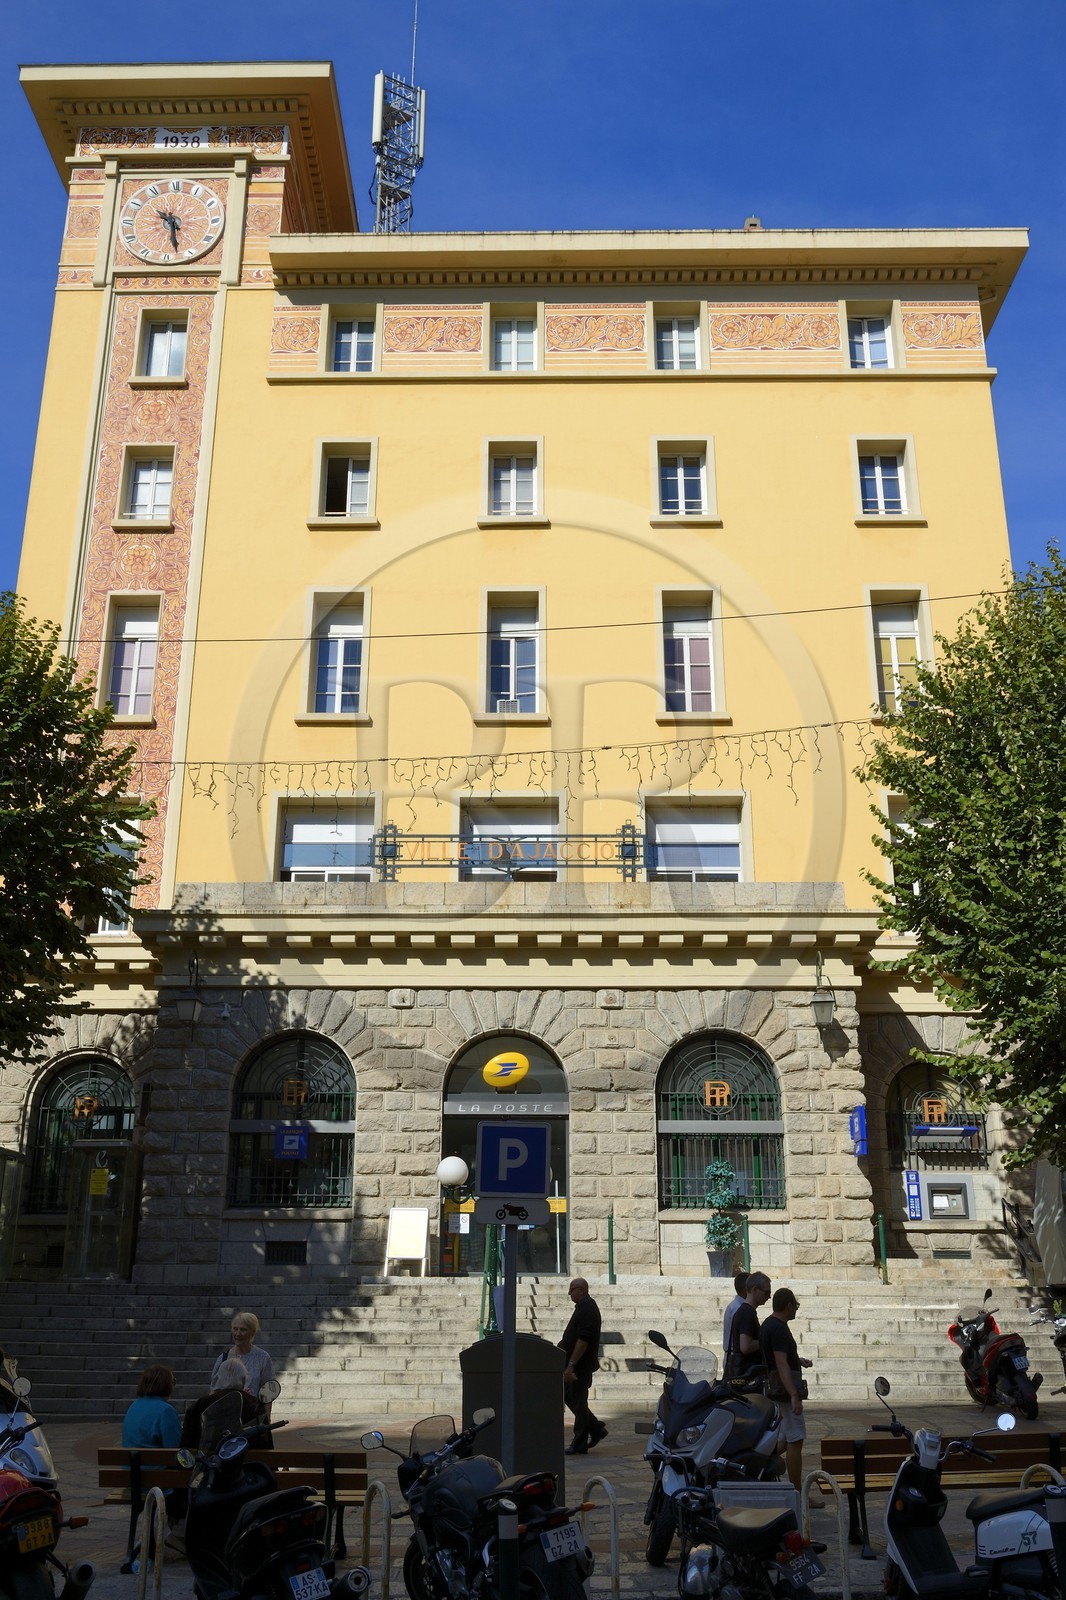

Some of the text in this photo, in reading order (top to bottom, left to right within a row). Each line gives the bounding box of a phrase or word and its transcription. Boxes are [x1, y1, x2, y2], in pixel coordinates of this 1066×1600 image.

[162, 135, 201, 148] 1938
[405, 842, 615, 861] VILLE D'AJACCIO
[458, 1104, 553, 1112] LA POSTE
[498, 1137, 529, 1181] P
[553, 1526, 577, 1542] 7195
[1021, 1531, 1037, 1546] 57
[551, 1540, 580, 1558] GZ 2A
[792, 1563, 821, 1585] FF 2A
[295, 1581, 329, 1600] 537-KA
